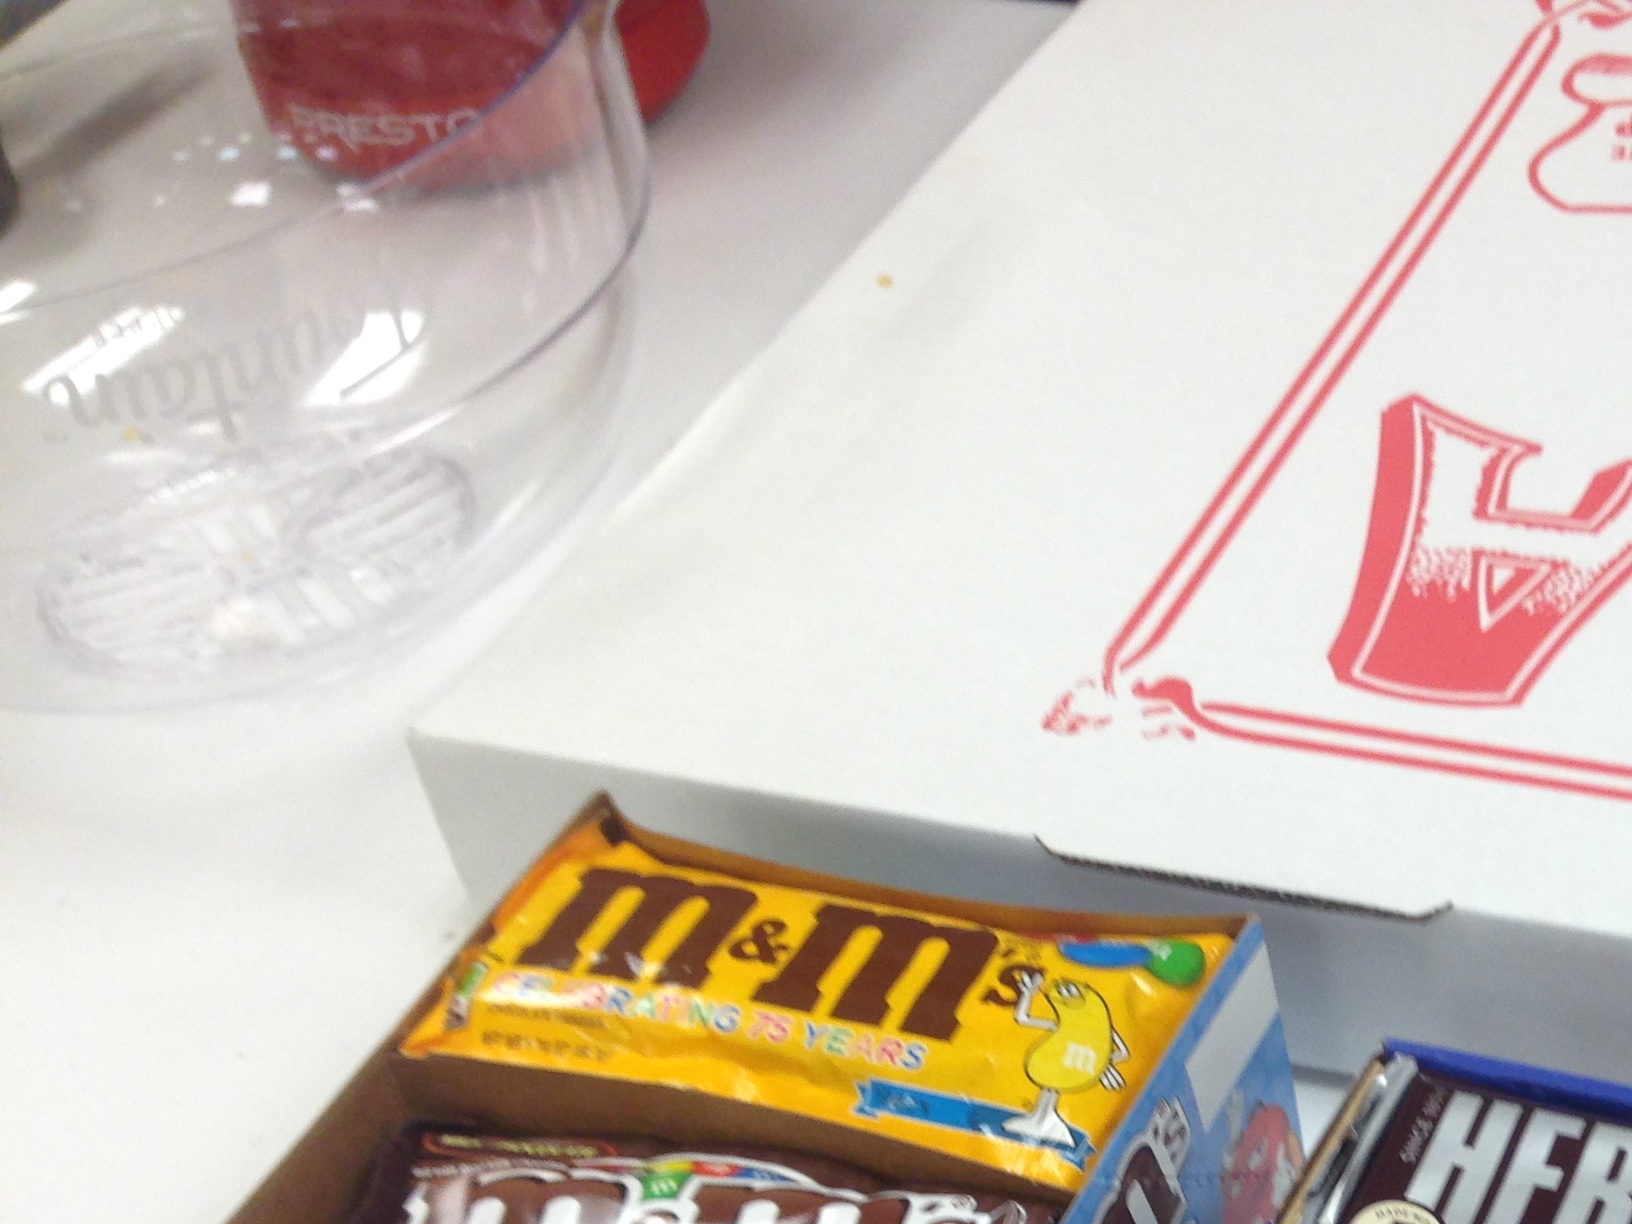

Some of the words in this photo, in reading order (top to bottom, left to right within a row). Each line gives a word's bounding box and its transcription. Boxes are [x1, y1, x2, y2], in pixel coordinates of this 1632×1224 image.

[490, 968, 742, 1036] CEBRATING
[747, 1009, 794, 1046] 75
[803, 1018, 929, 1072] YEARS
